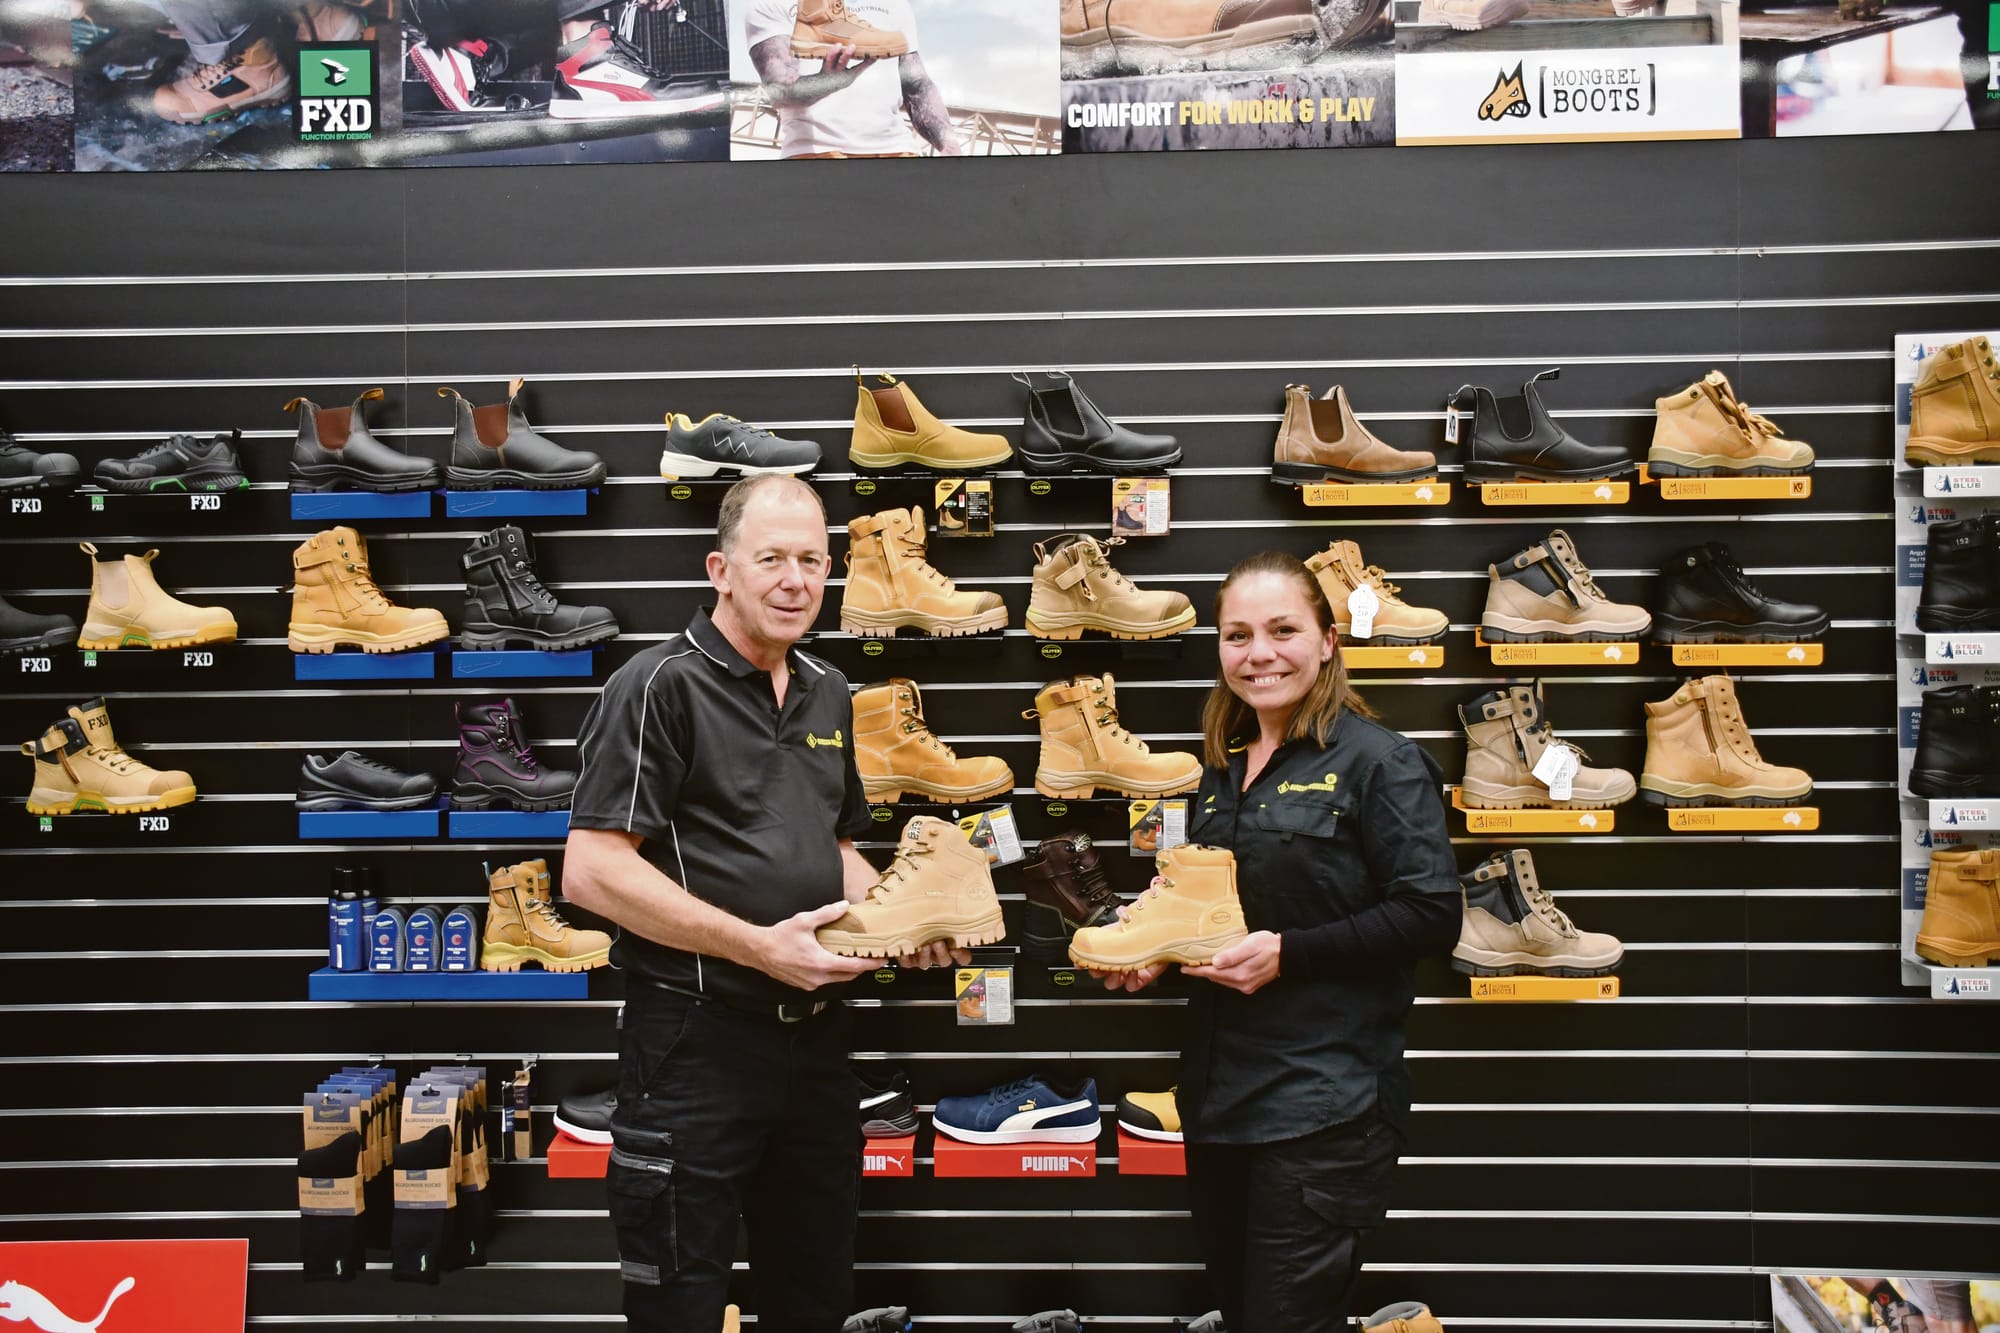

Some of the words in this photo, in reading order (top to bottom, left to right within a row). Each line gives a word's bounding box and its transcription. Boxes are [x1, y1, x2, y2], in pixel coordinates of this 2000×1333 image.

[1553, 88, 1640, 112] BOOTS
[1067, 101, 1175, 127] COMFORT
[1179, 100, 1222, 125] FOR
[1227, 98, 1293, 124] WORK
[1299, 98, 1315, 122] &
[1319, 97, 1375, 122] PLAY
[347, 132, 372, 140] DESIGN
[1793, 483, 1803, 493] K9
[11, 498, 42, 513] FXD
[190, 495, 221, 510] FXD
[21, 658, 51, 672] FXD
[184, 652, 213, 666] FXD
[87, 714, 109, 731] FXD
[139, 817, 169, 831] FXD
[1602, 984, 1612, 995] K9
